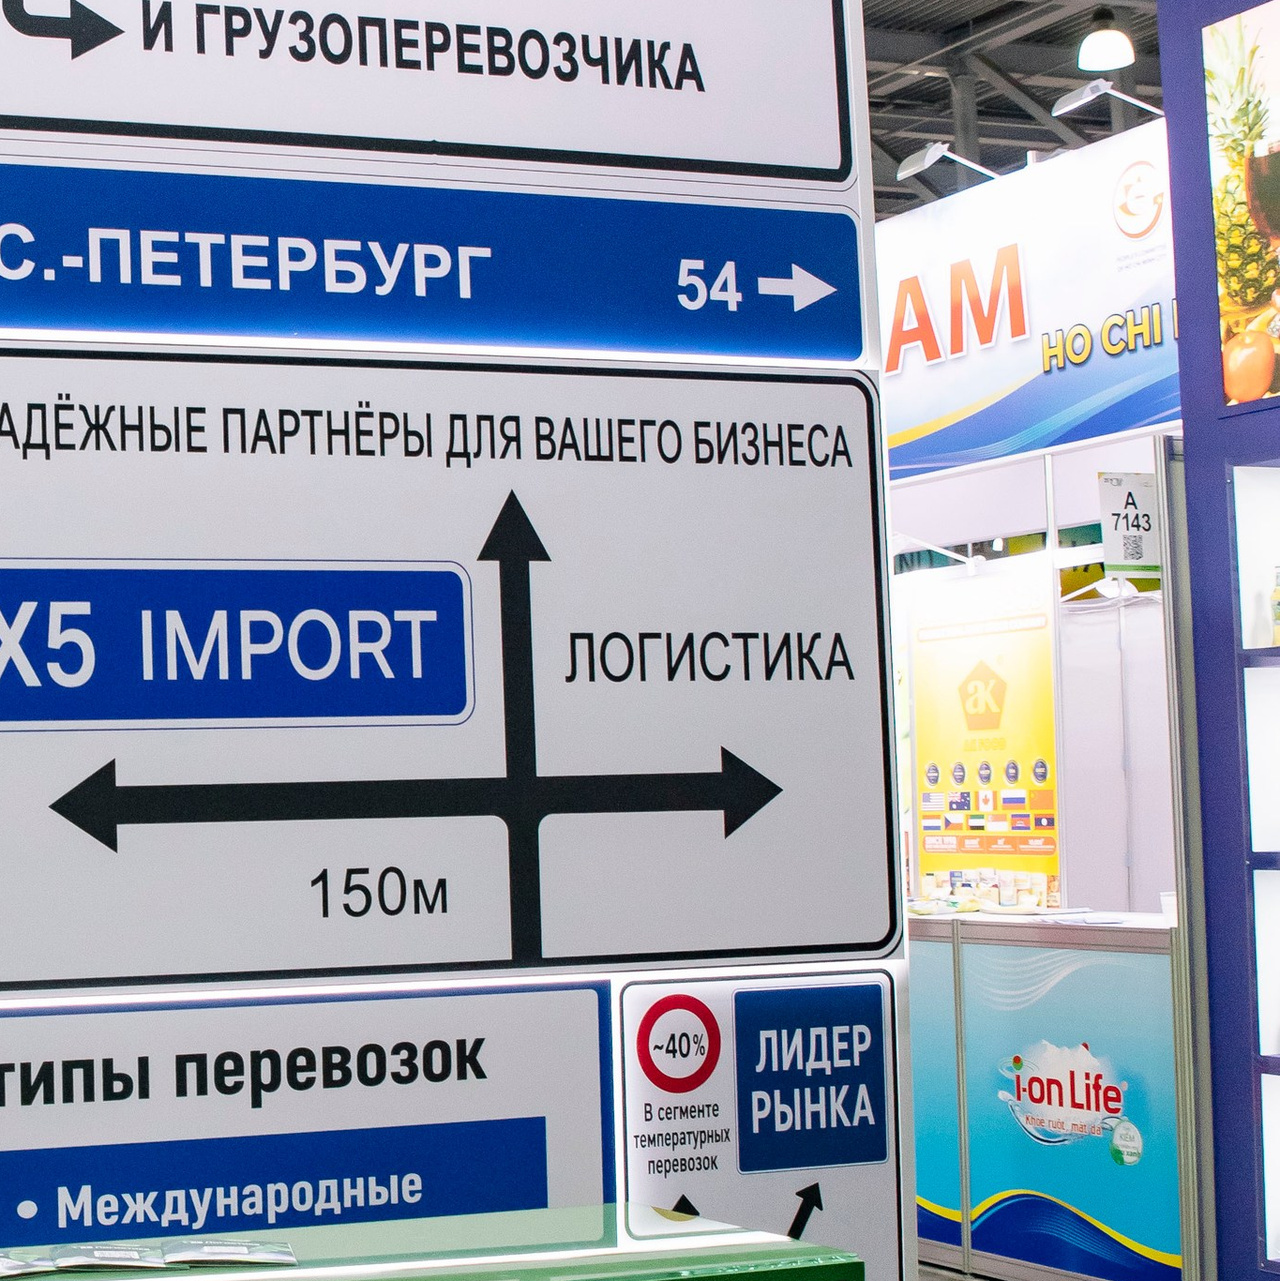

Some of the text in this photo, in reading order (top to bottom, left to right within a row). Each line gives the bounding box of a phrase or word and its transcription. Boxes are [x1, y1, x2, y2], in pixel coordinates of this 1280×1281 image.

[141, 0, 706, 93] И ГРУЗОПЕРЕВОЗЧИКА
[676, 259, 742, 312] 54
[1042, 324, 1093, 372] HO
[1100, 302, 1163, 356] CHI
[221, 399, 434, 459] ПАРТНЁРЫ
[445, 413, 523, 468] ДЛЯ
[534, 417, 682, 465] ВАШЕГО
[694, 420, 853, 469] БИЗНЕСА
[1111, 513, 1151, 532] 7143
[1124, 492, 1138, 510] A
[140, 606, 438, 682] IMPORT
[564, 630, 856, 685] ЛОГИСТИКА
[309, 866, 450, 920] 150м
[652, 1031, 706, 1059] ~40%
[755, 1024, 872, 1077] ЛИДЕР
[175, 1037, 488, 1108] перевозок
[1069, 1070, 1122, 1115] Life
[644, 1102, 720, 1122] В сегменте
[751, 1083, 876, 1134] РЫНКА
[633, 1126, 731, 1151] температурных
[648, 1155, 719, 1179] перевозок
[56, 1170, 424, 1233] Международные
